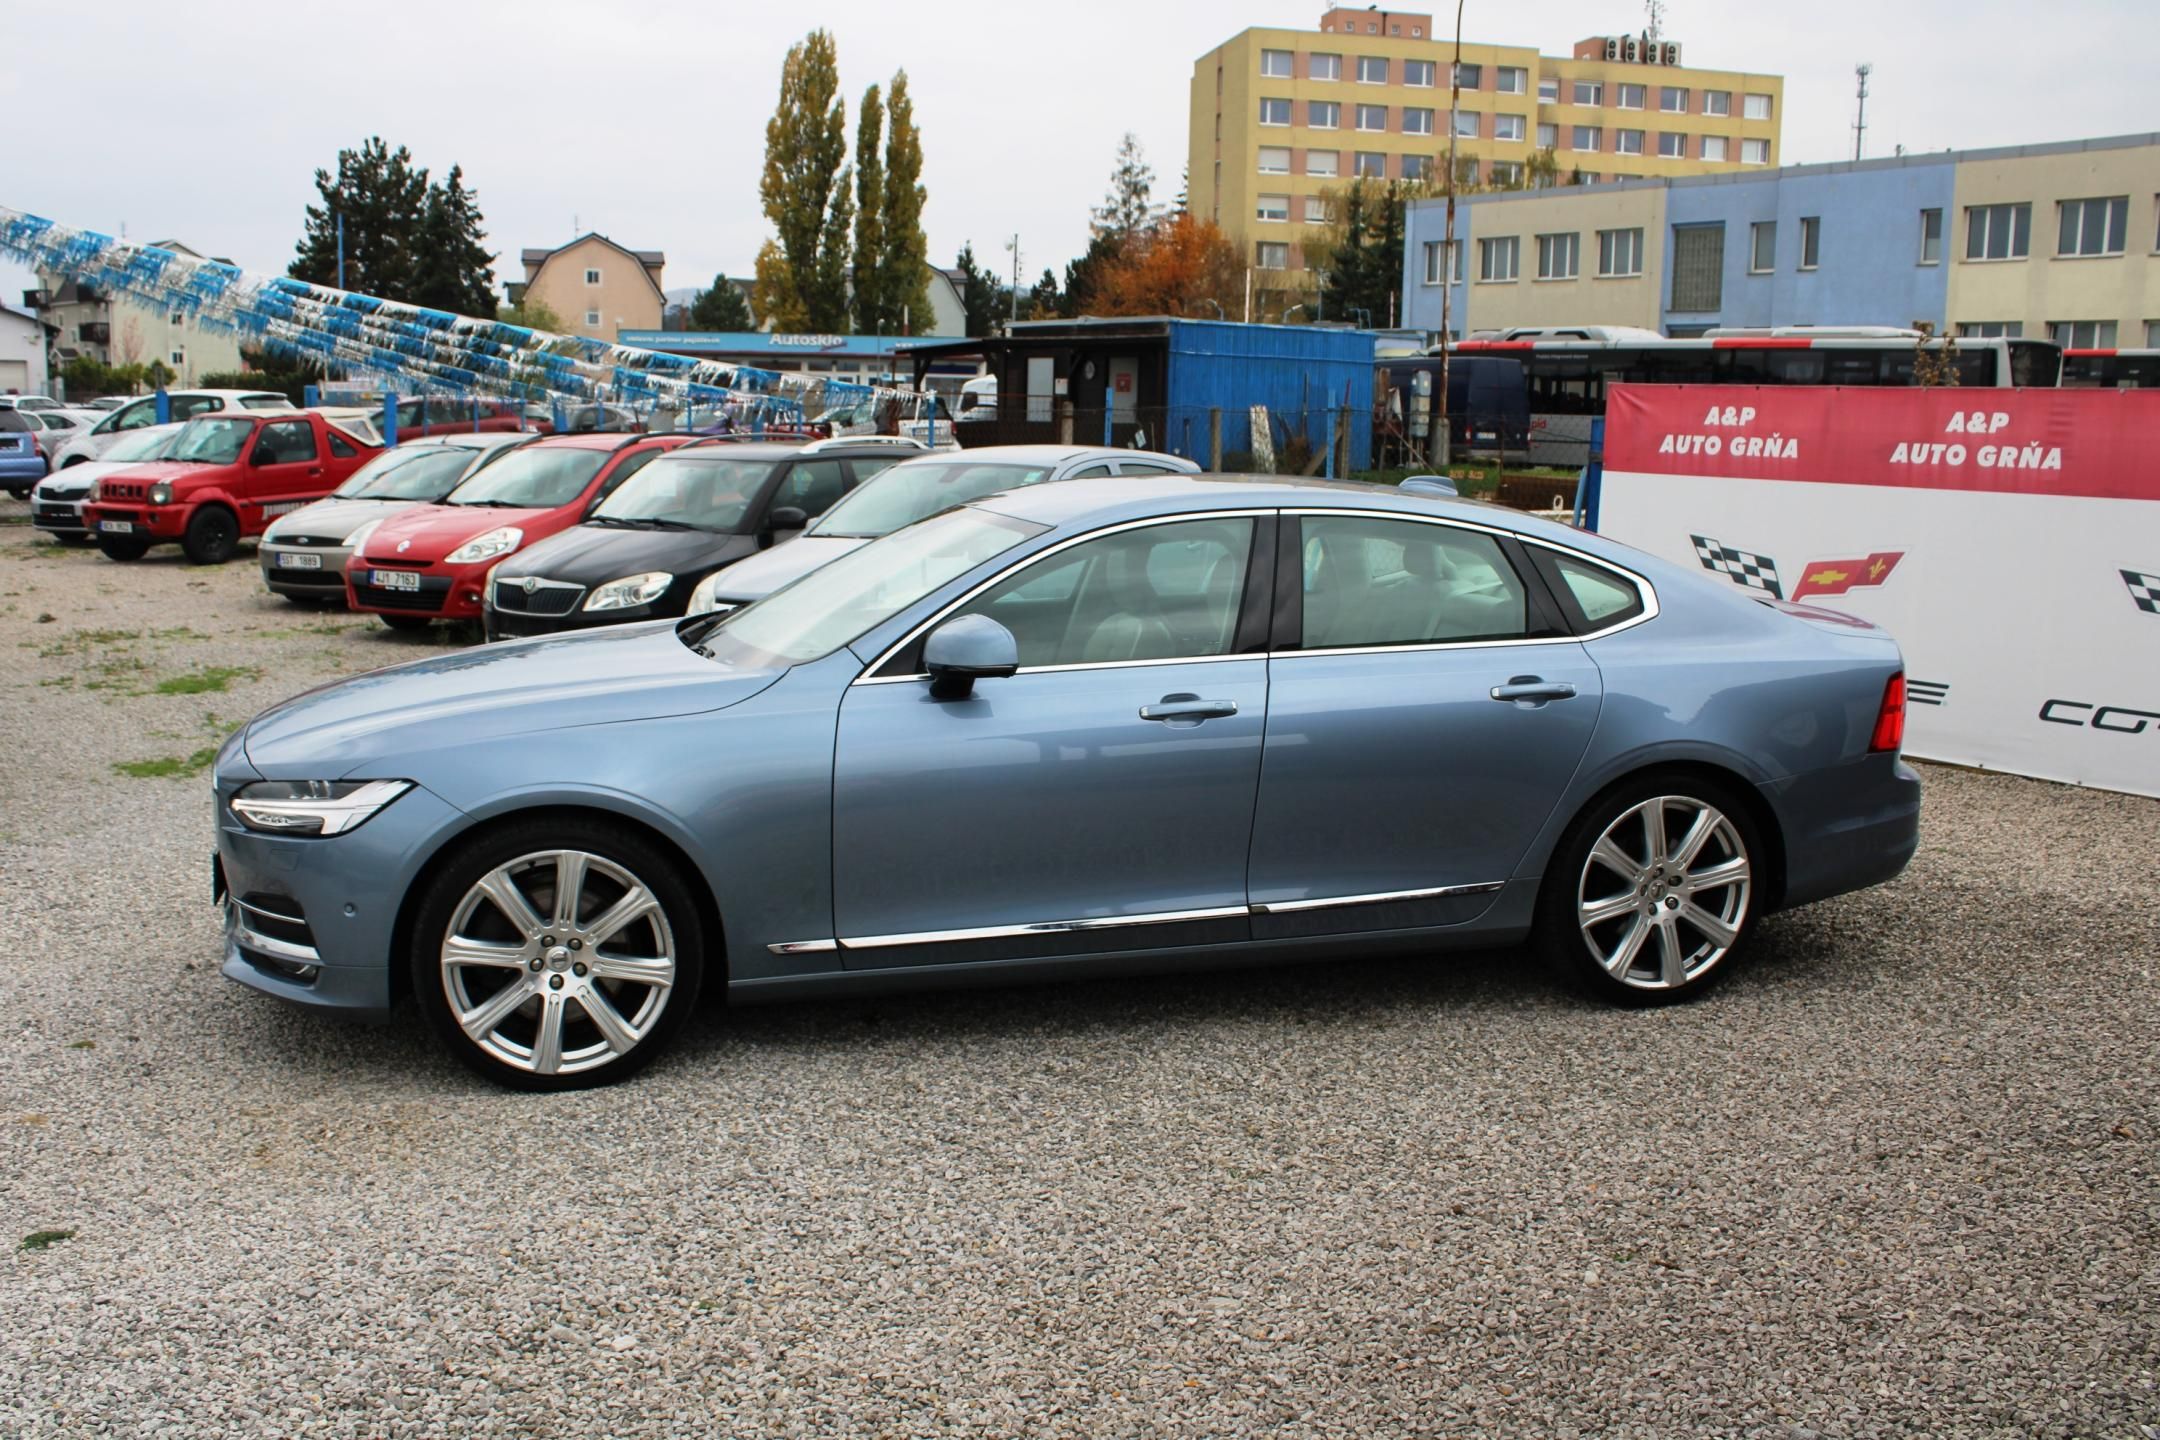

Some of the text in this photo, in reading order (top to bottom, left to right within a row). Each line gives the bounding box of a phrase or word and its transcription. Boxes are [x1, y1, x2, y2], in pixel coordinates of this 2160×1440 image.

[768, 334, 843, 346] Autosklo
[1704, 406, 1756, 426] A&P
[1945, 411, 2009, 433] A&P
[1658, 432, 1799, 458] AUTO GRŇA
[1889, 441, 2062, 470] AUTO GRŇA
